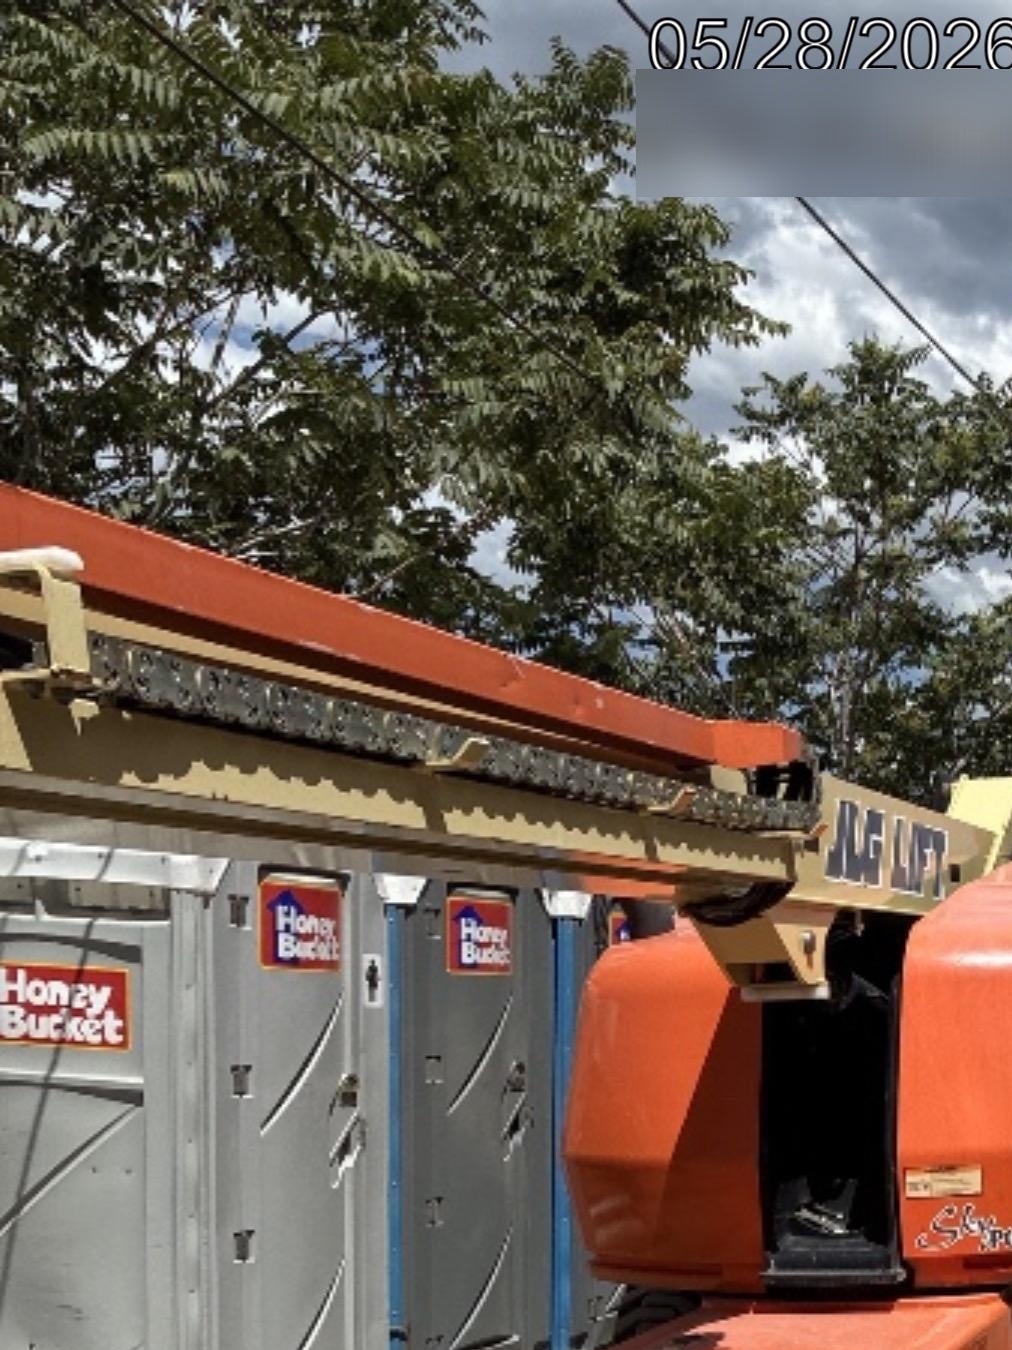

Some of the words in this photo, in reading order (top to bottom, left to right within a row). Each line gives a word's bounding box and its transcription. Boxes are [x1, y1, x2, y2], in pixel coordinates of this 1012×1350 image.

[825, 799, 886, 888] JLG
[890, 816, 949, 901] LIFT
[0, 967, 112, 1018] Honey
[0, 1004, 124, 1045] Bucket
